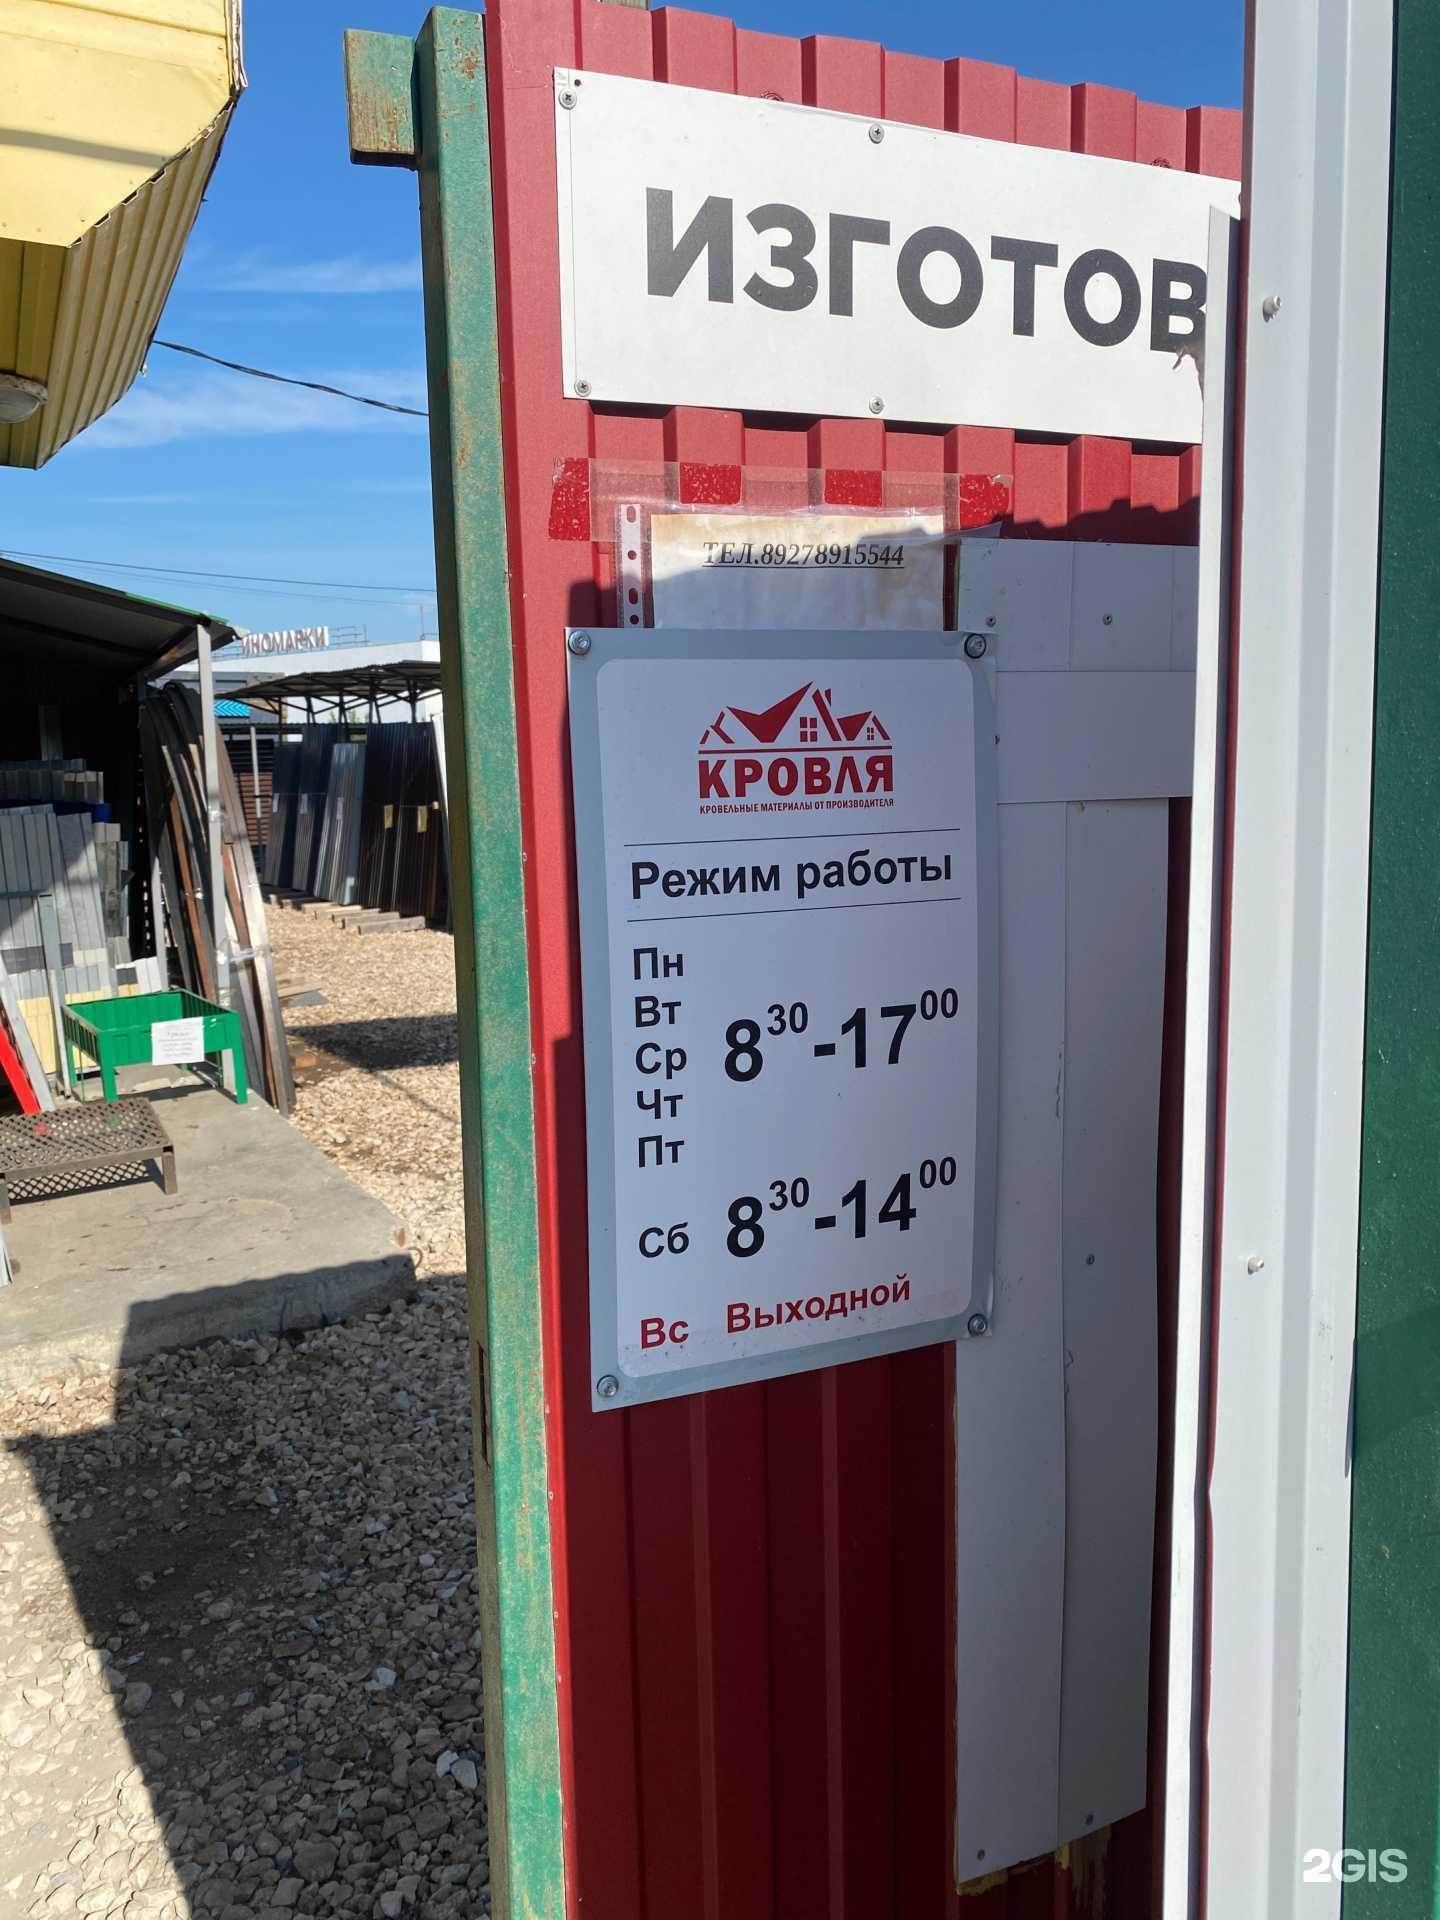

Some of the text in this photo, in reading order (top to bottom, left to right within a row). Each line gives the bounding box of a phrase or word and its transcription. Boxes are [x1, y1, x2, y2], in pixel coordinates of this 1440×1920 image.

[703, 542, 905, 566] ТЕЛ.89278915544
[698, 755, 894, 799] КРОВЛЯ
[700, 798, 895, 815] КРОВЕЛЬНЫЕ МАТЕРИАЛЫ ОТ ПРОИЗВОДИТЕЛЯ
[631, 848, 952, 900] Режим работы
[633, 947, 684, 981] Пн
[634, 994, 682, 1028] Вт
[635, 1042, 688, 1080] Ср
[636, 1088, 684, 1120] Чт
[638, 1134, 685, 1168] Пт
[638, 1221, 690, 1259] Сб
[640, 1273, 912, 1349] Вс Выходной
